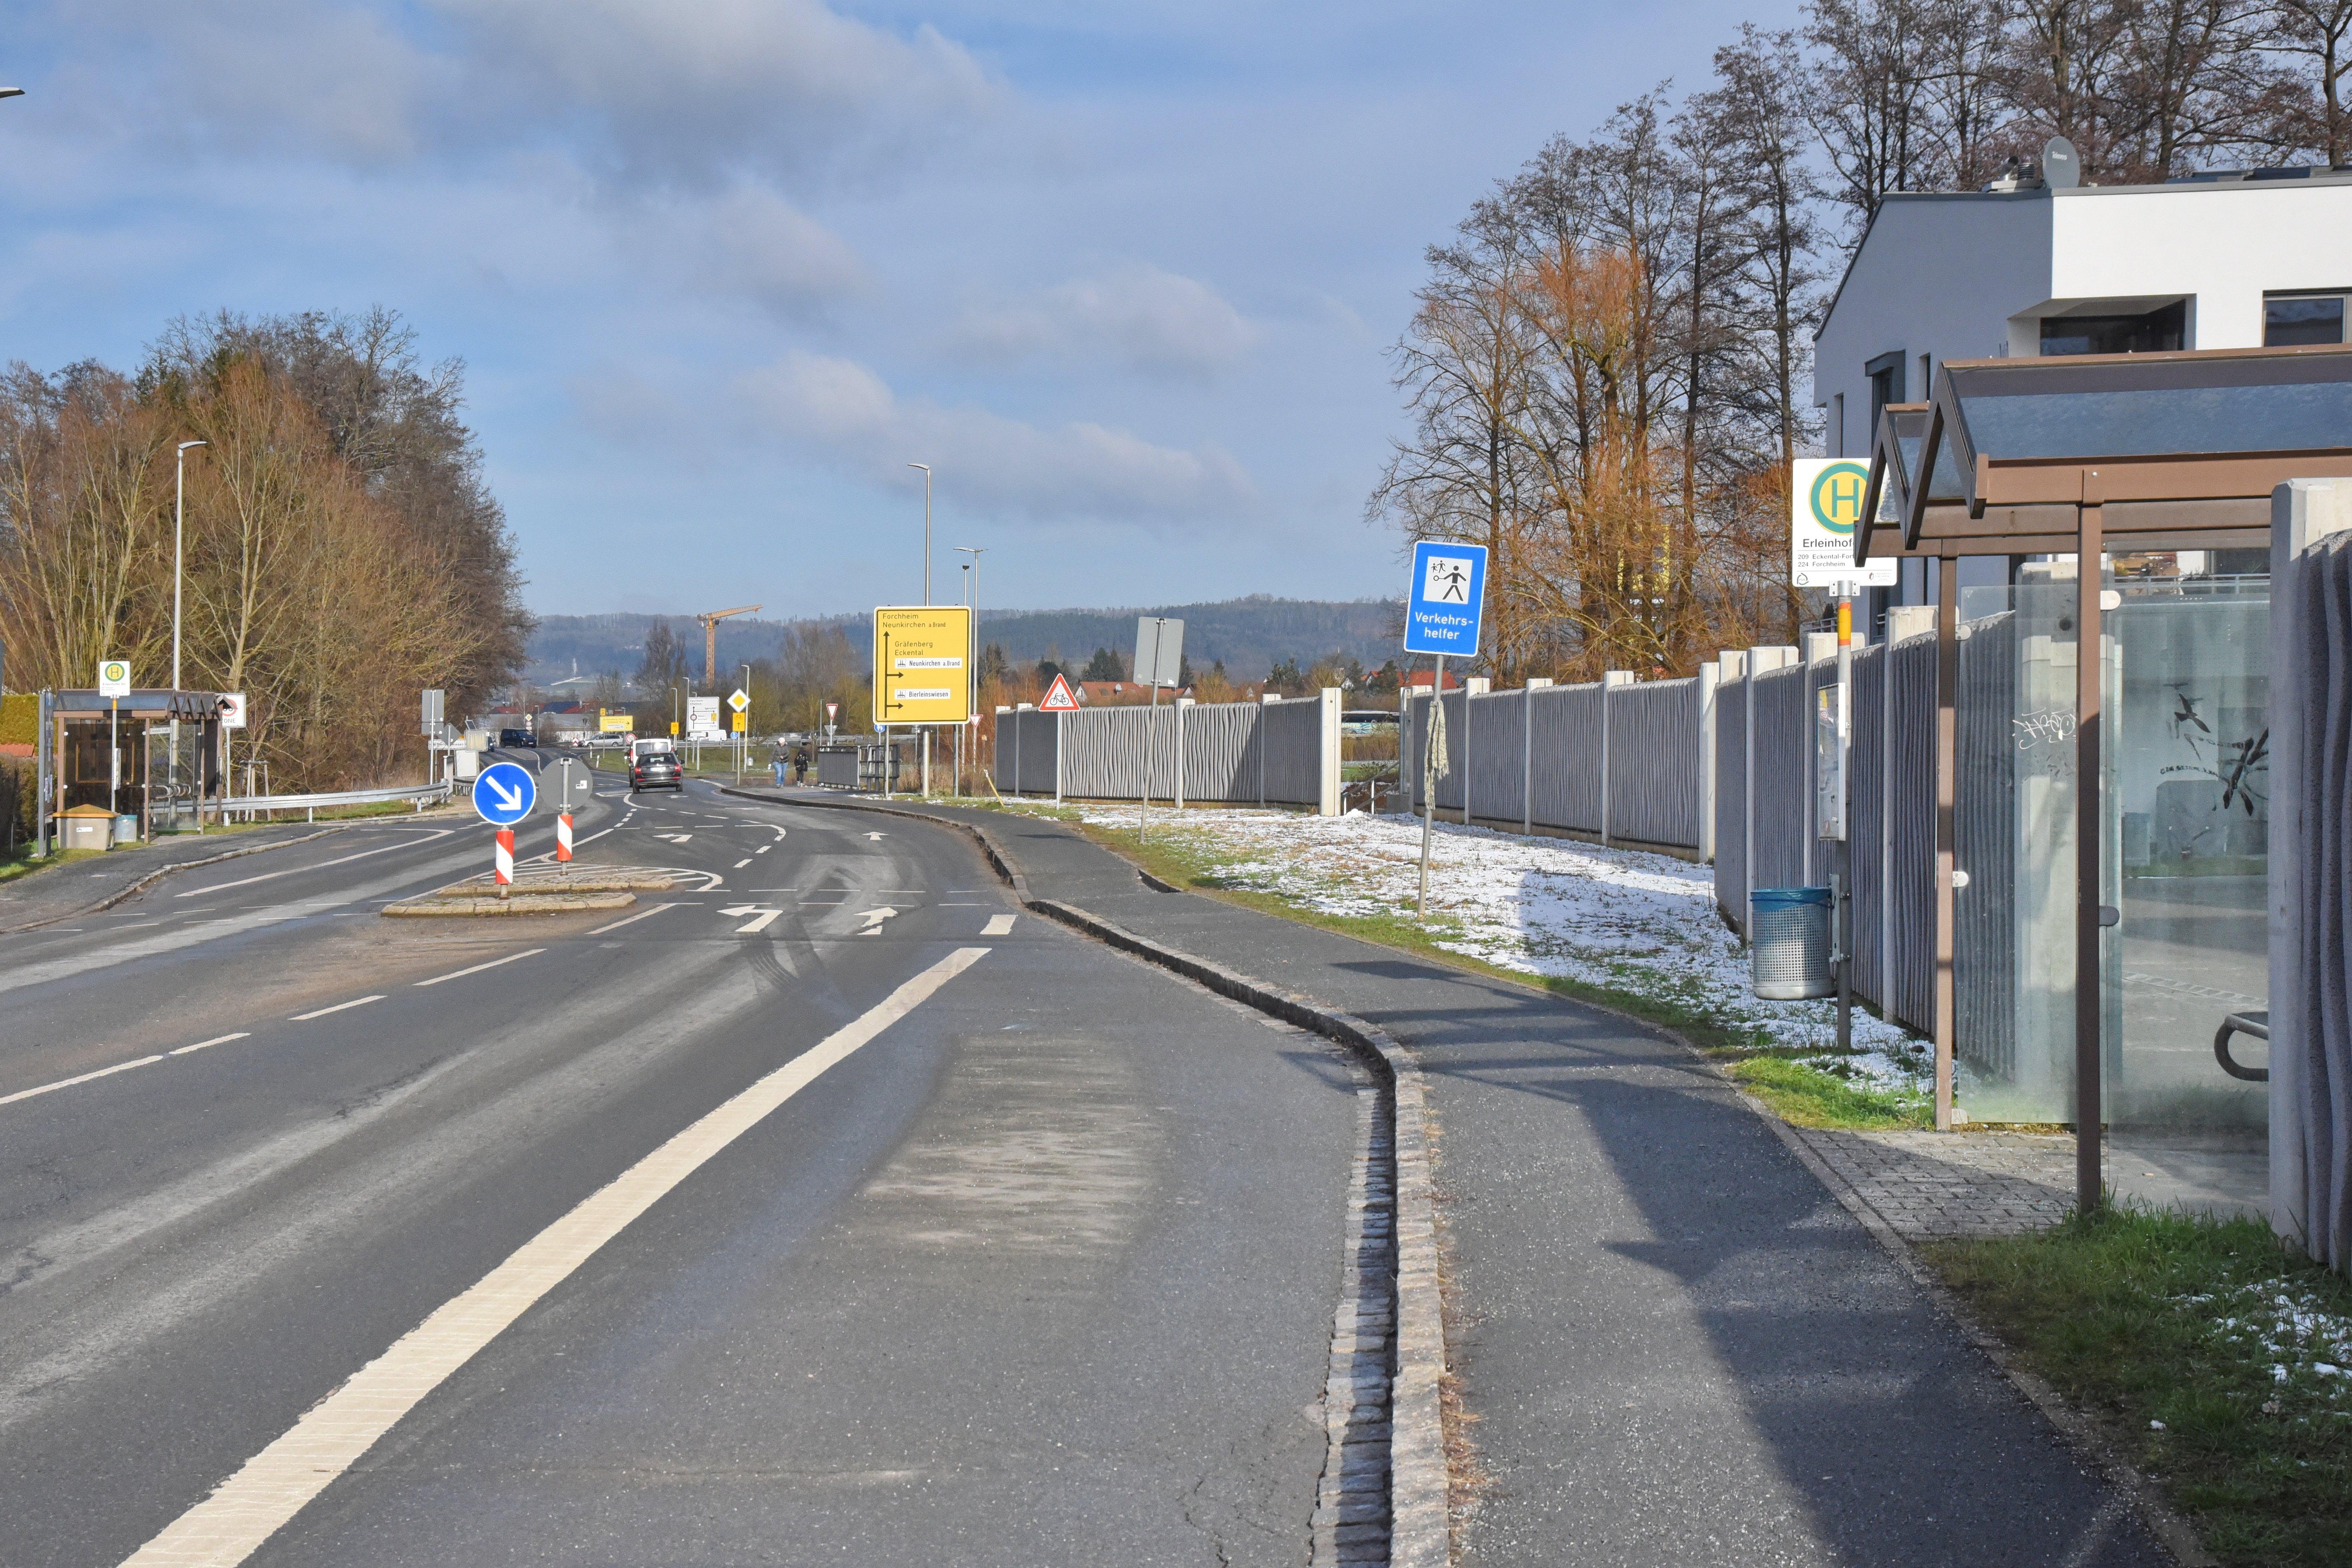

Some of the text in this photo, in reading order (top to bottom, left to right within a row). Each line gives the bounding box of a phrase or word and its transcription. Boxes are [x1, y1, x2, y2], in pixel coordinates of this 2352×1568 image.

[1831, 479, 1859, 518] H
[1803, 538, 1854, 547] Erleinhof
[1415, 612, 1473, 626] Verkehrs-
[1425, 627, 1460, 639] helfer
[111, 666, 119, 678] H
